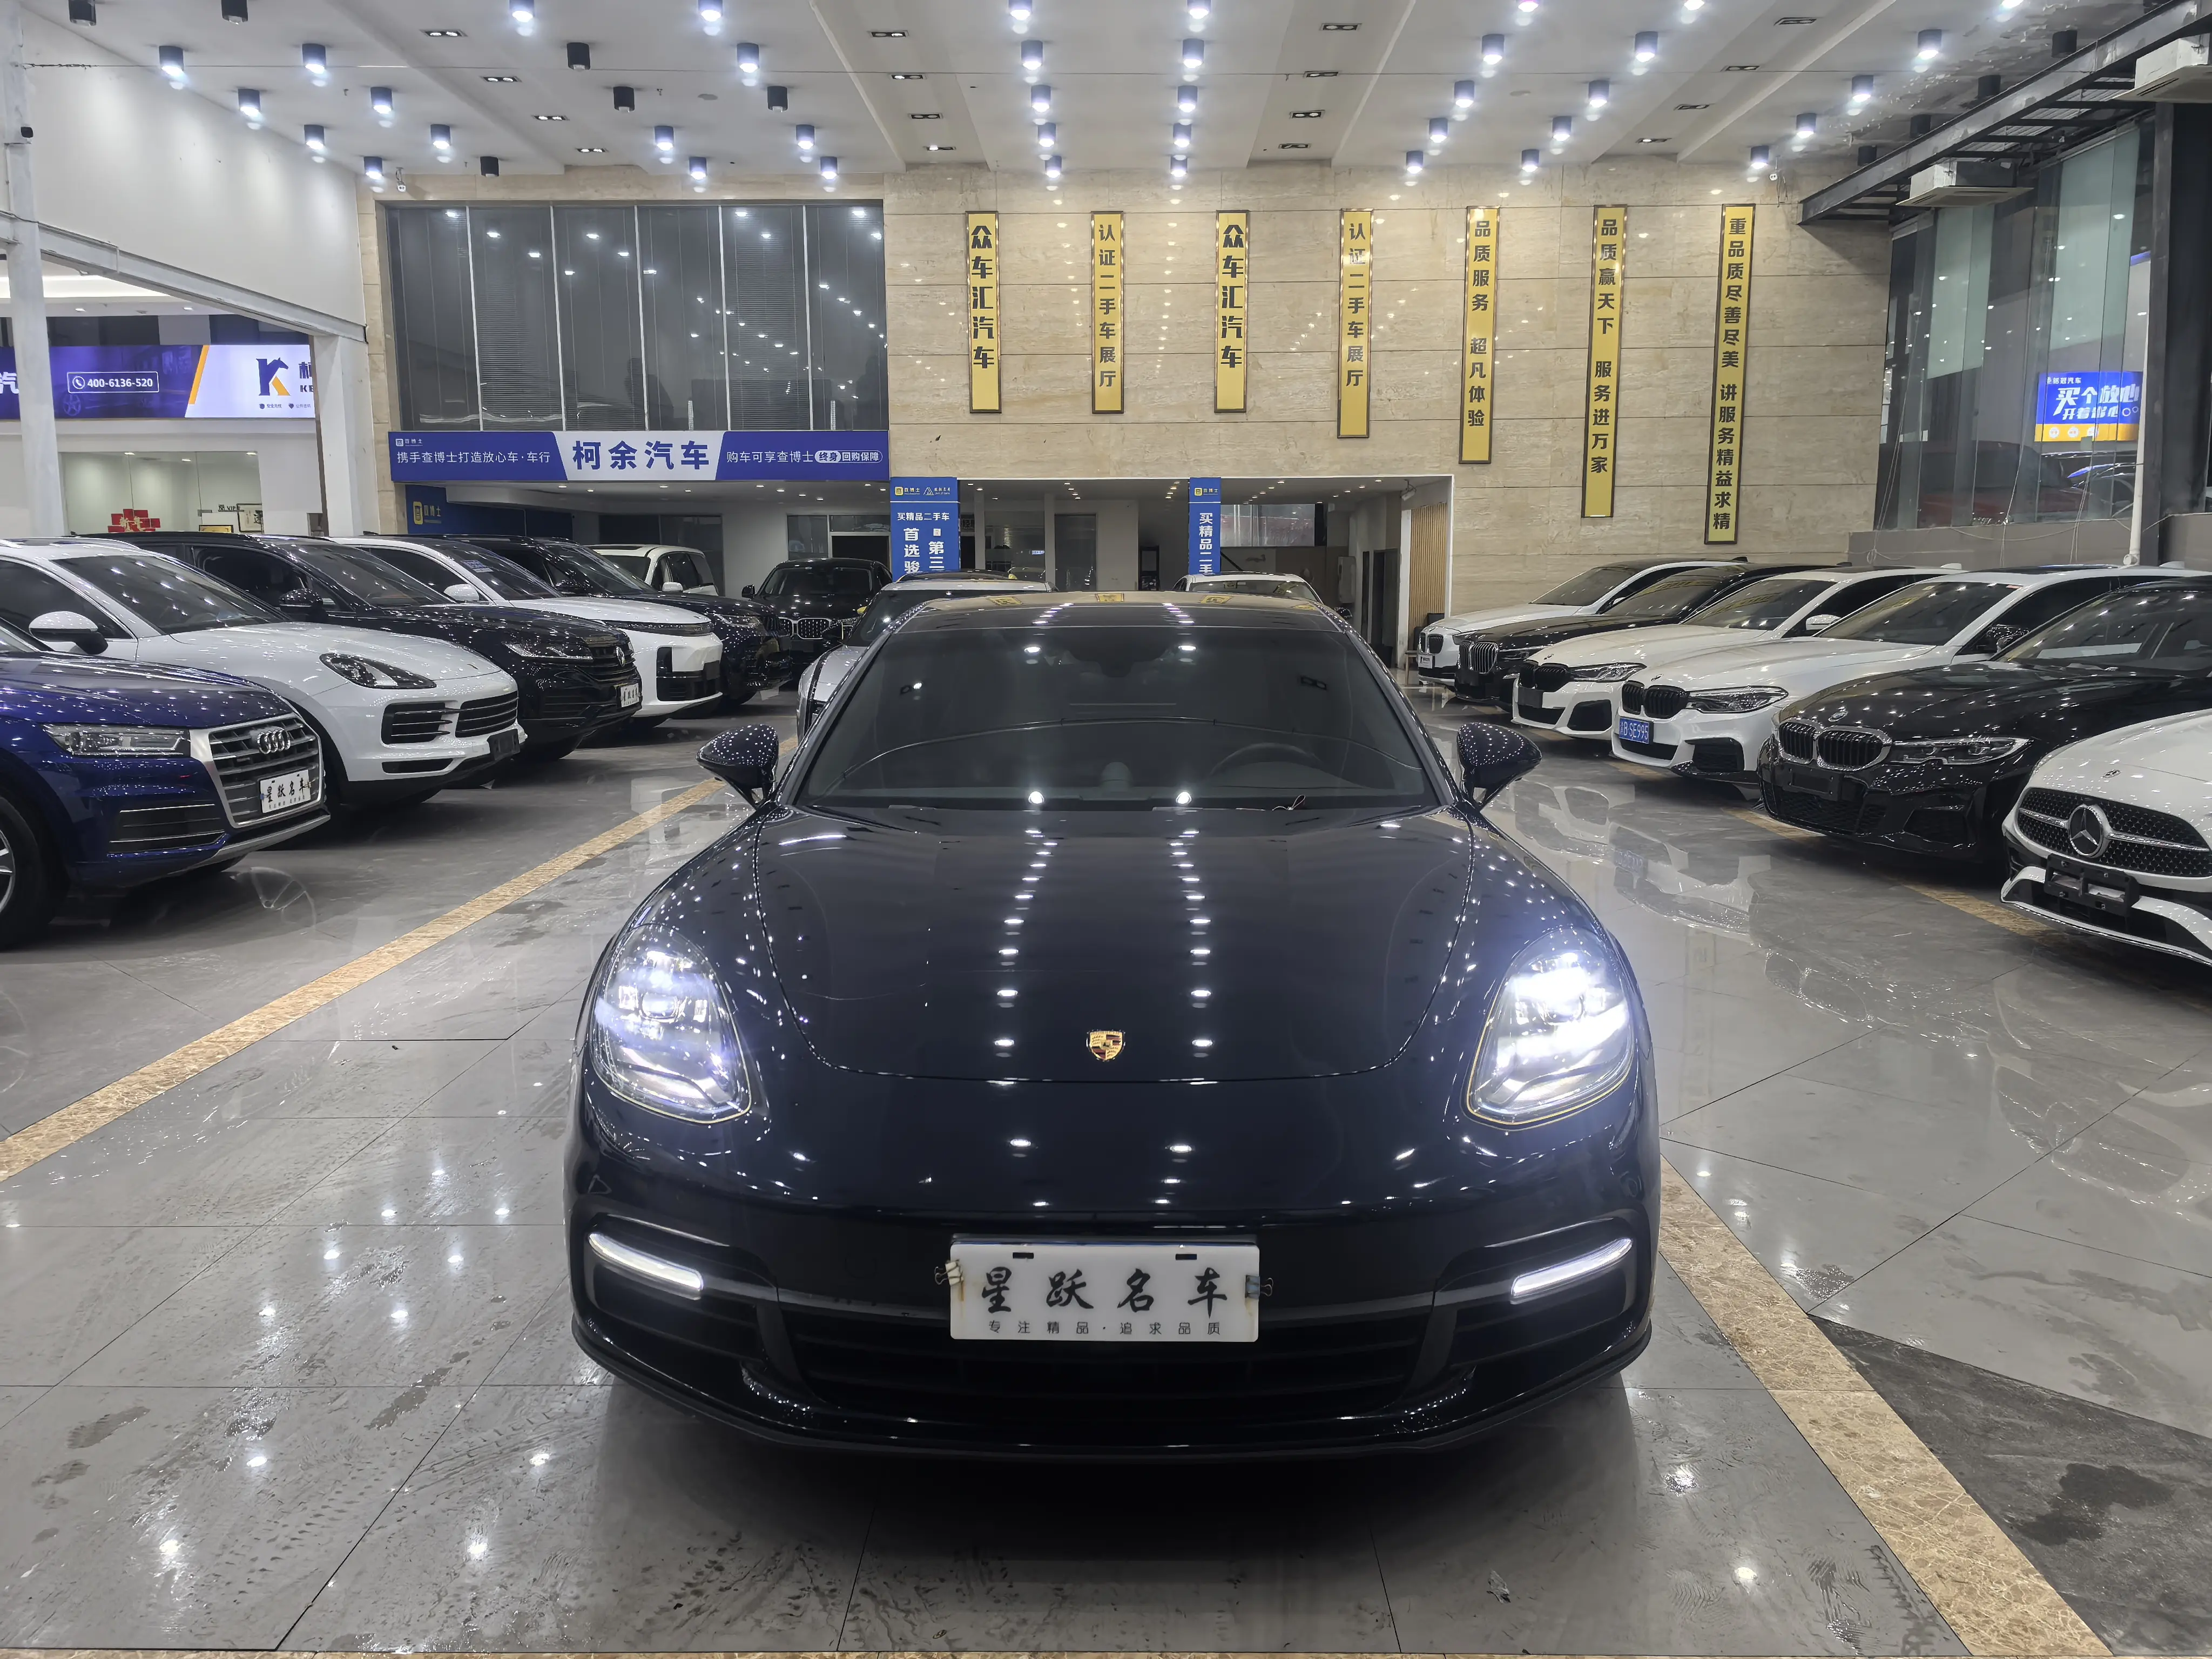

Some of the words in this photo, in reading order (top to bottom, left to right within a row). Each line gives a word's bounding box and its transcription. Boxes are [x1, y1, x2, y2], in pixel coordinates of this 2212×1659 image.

[971, 225, 994, 368] 众车汇汽车
[1098, 224, 1116, 387] 认证二手车展厅
[1220, 224, 1244, 368] 众车汇汽车
[1346, 223, 1366, 387] 认证二手车展厅
[1472, 220, 1491, 312] 品质服务
[1597, 219, 1618, 334] 品质赢天下
[1721, 218, 1746, 368] 重品质尽善尽美
[87, 378, 153, 388] 400-6136-520
[1467, 338, 1487, 427] 超凡体验
[1590, 361, 1611, 474] 服务进万家
[572, 440, 710, 470] 柯余汽车
[1712, 384, 1737, 530] 讲服务精益求精
[897, 512, 950, 521] 买精品二手车
[1199, 512, 1213, 574] 买精品二手
[981, 1266, 1228, 1319] 星跃名车
